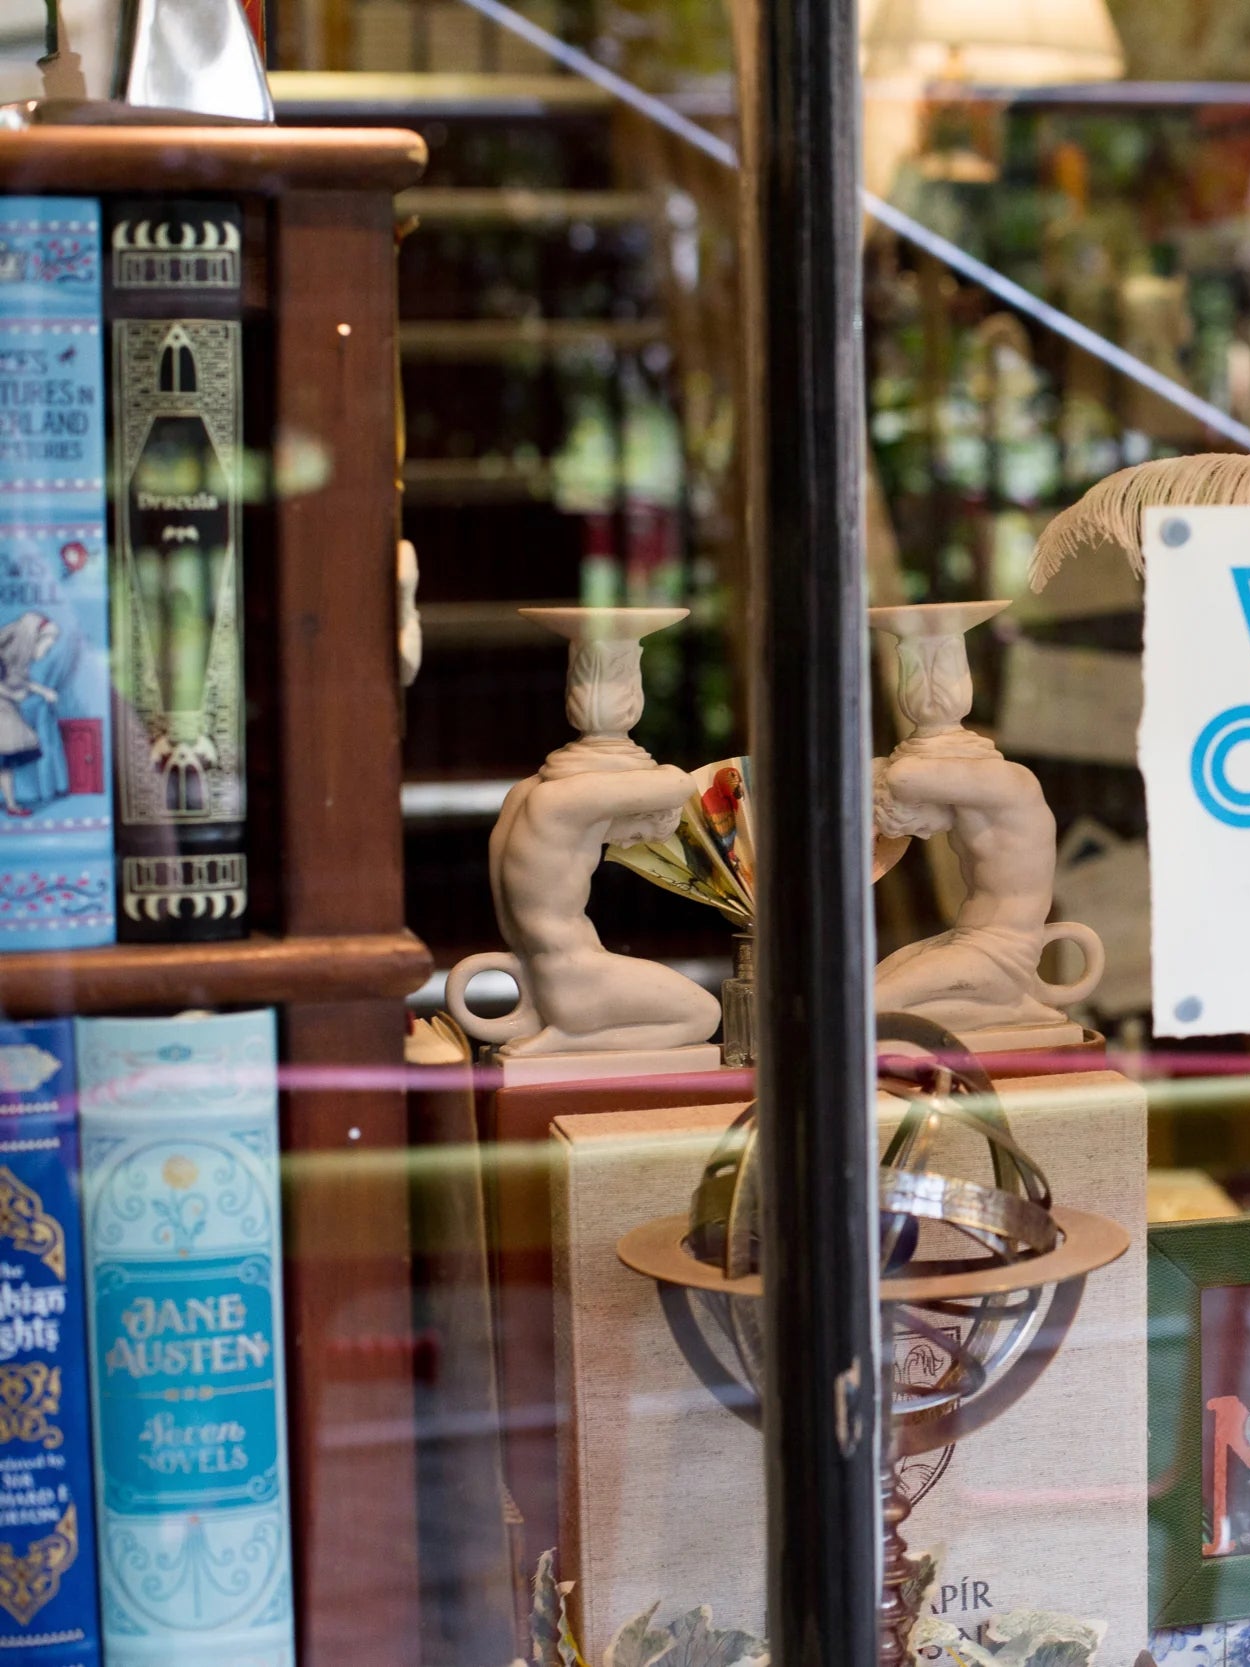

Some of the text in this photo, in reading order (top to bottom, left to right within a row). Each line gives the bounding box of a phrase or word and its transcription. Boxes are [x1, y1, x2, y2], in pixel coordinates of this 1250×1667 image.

[137, 493, 218, 511] Dracula
[0, 1281, 66, 1319] bian
[123, 1293, 247, 1340] JANE
[106, 1332, 270, 1378] AUSTEN
[139, 1445, 249, 1474] NOVELS
[930, 1575, 994, 1615] PÍR
